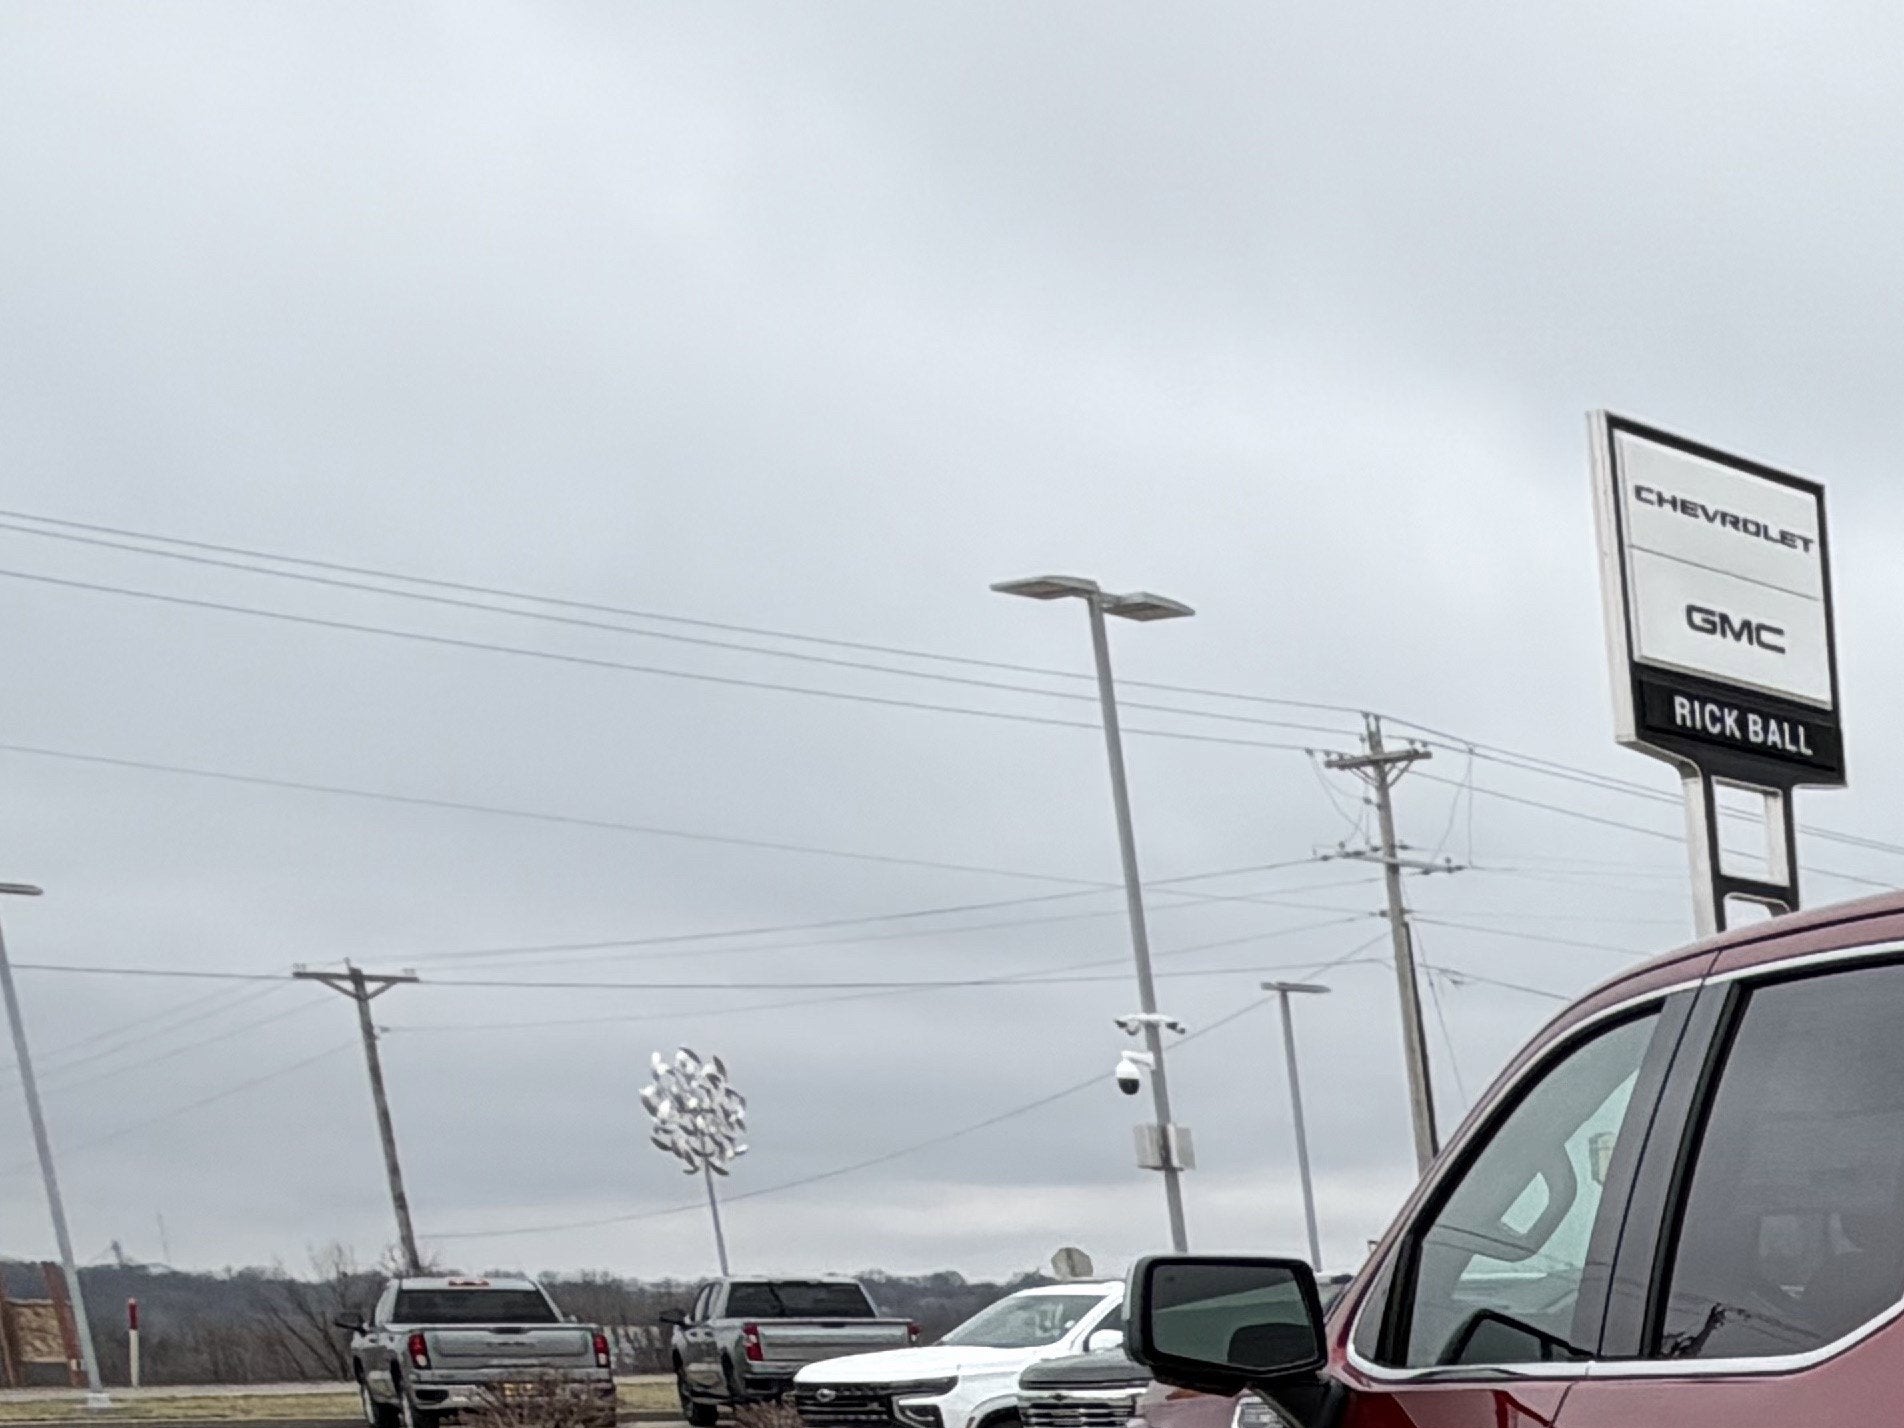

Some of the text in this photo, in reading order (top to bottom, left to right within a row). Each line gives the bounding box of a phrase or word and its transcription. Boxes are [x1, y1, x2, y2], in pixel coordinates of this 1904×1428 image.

[1634, 484, 1814, 553] CHEVROLET
[1686, 604, 1786, 654] GMC
[1674, 695, 1814, 757] RICK BALL
